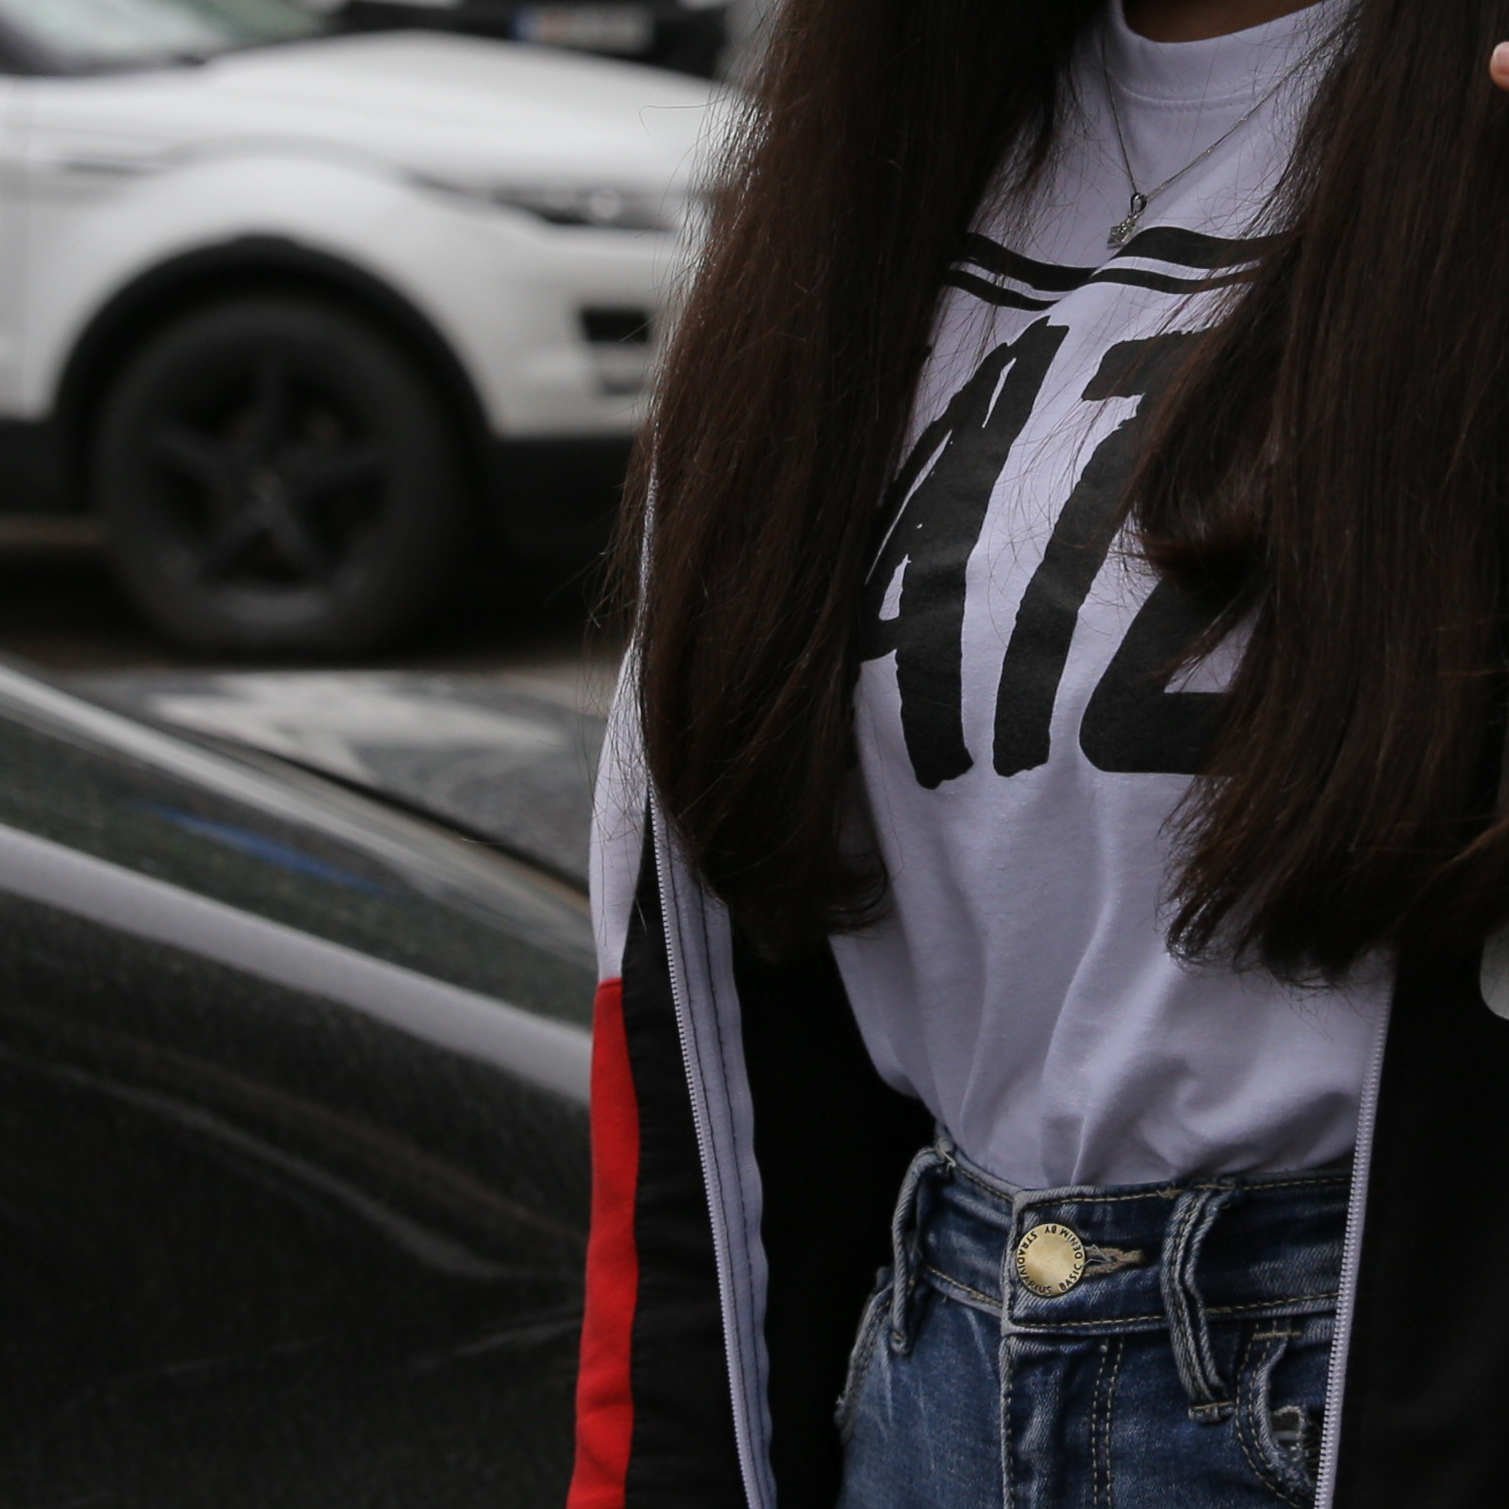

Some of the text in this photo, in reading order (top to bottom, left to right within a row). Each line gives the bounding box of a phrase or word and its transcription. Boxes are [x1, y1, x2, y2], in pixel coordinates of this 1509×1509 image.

[1017, 1225, 1083, 1294] BASIC DENIM BY STRADIVARIUS
